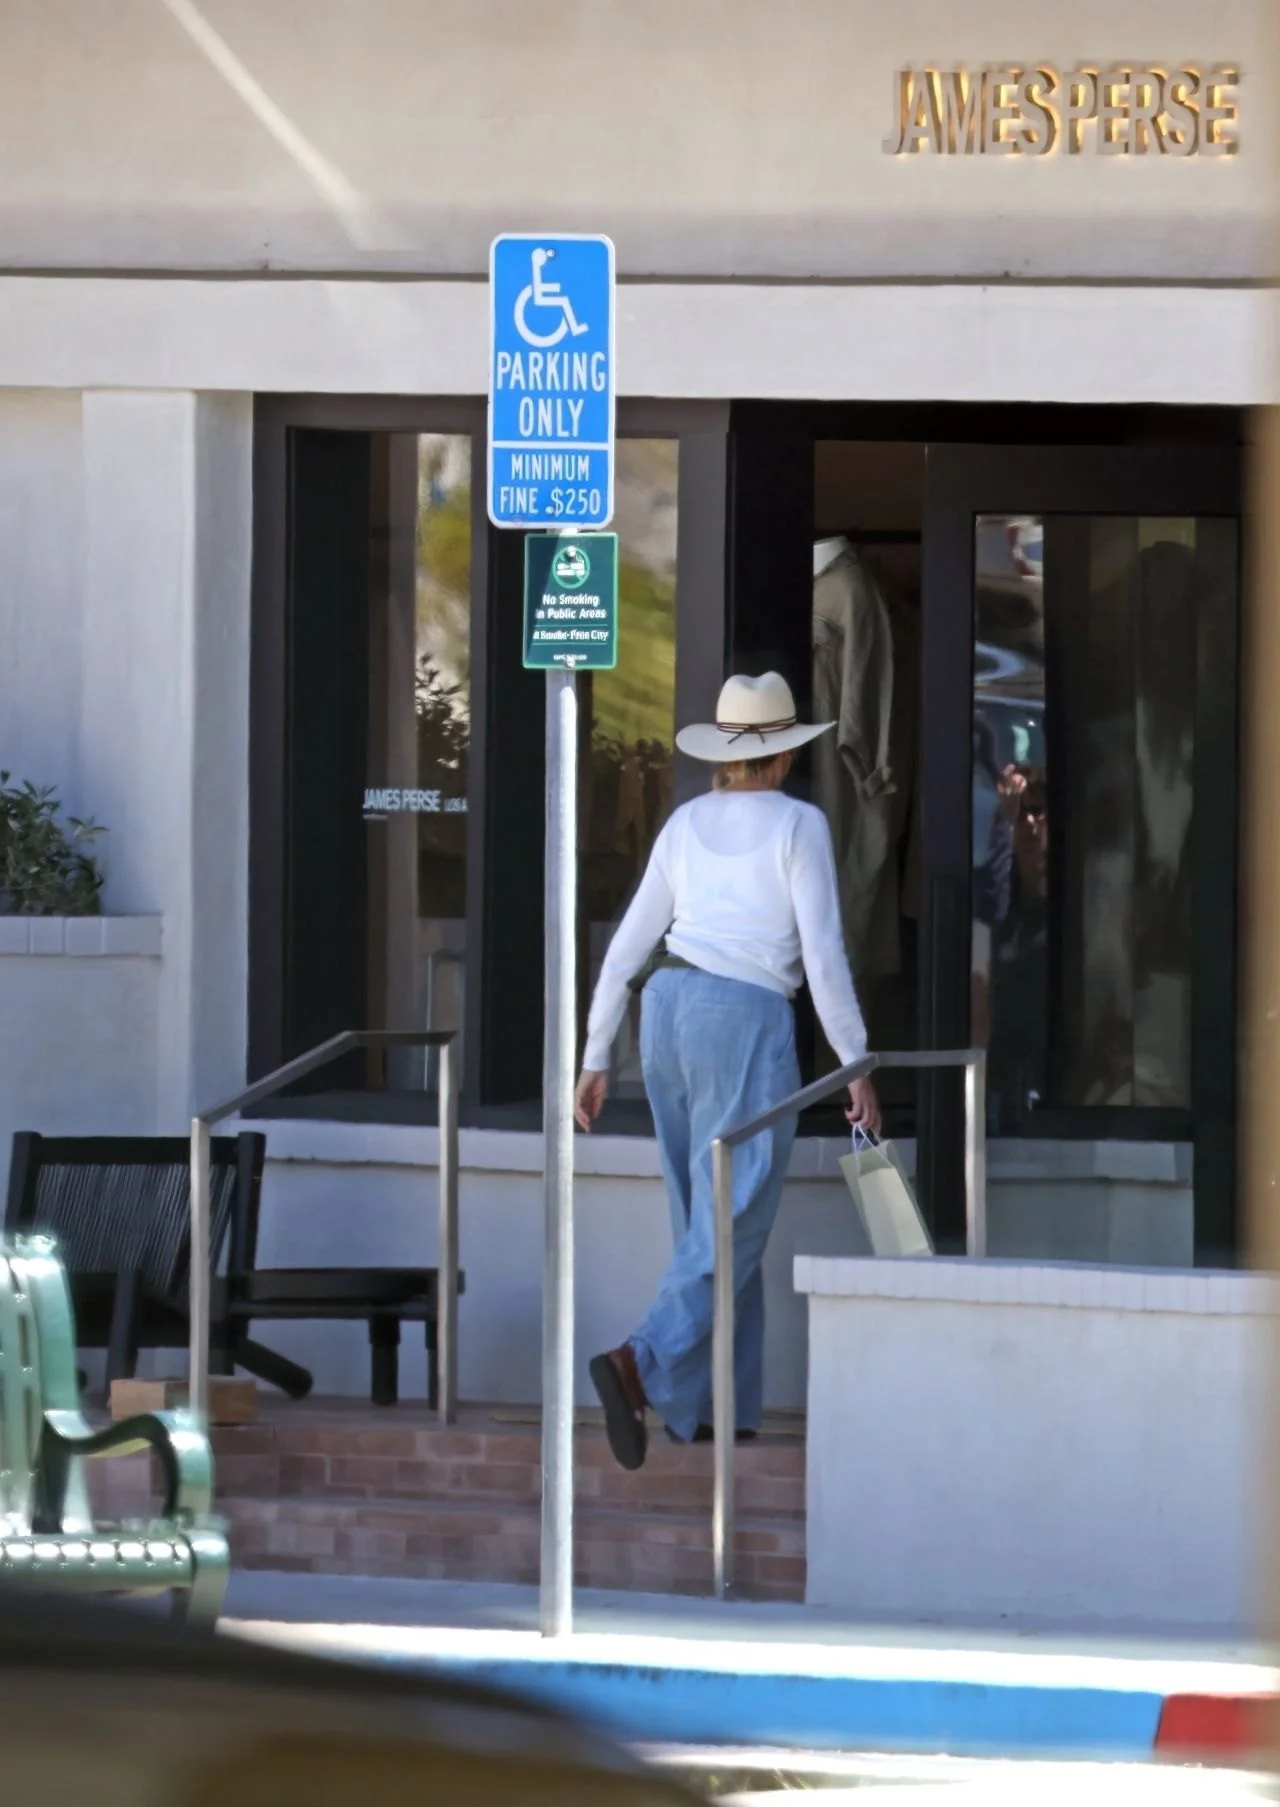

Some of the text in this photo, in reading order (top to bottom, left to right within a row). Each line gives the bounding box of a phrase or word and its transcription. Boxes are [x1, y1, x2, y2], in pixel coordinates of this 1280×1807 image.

[882, 63, 1239, 156] JAMES PERSE
[496, 351, 606, 392] PARKING
[519, 396, 584, 438] ONLY
[511, 453, 590, 481] MINIMUM
[500, 486, 539, 514] FINE
[543, 593, 600, 607] No Smoking
[547, 608, 577, 619] Public
[579, 608, 607, 619] Areas
[590, 629, 609, 641] City
[362, 788, 400, 810] JAMES
[401, 789, 442, 812] PERSE
